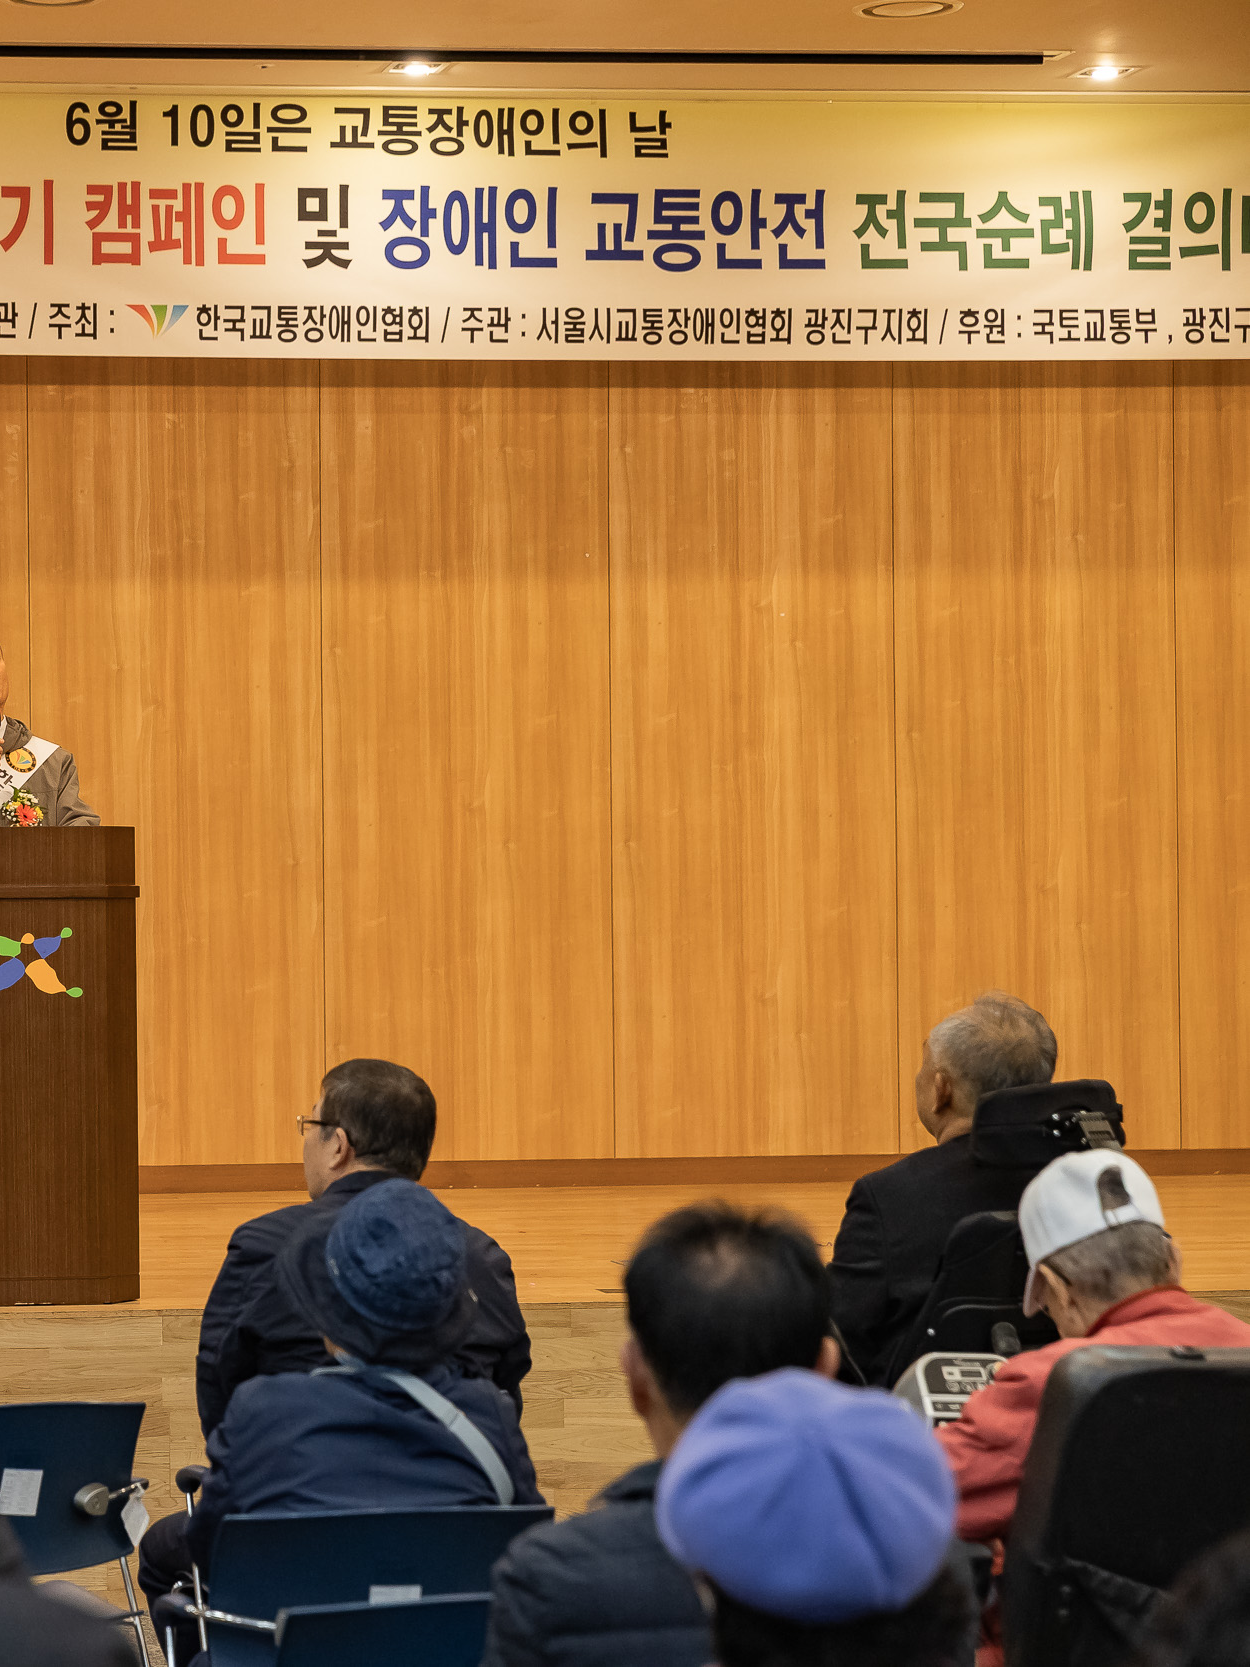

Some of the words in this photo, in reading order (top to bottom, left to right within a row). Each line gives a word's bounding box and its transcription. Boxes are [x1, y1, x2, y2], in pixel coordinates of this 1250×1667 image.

[65, 99, 138, 152] 6월
[162, 102, 312, 154] 10일은
[329, 104, 608, 159] 교통장애인의
[628, 109, 673, 159] 날
[84, 180, 266, 267] 캠페인
[297, 183, 353, 270] 및
[378, 185, 559, 270] 장애인
[584, 188, 827, 273] 교통안전
[852, 189, 1094, 272] 전국순례
[48, 302, 98, 341] 주최
[196, 303, 430, 344] 한국교통장애인협회
[460, 306, 512, 344] 주관
[536, 306, 793, 346] 서울시교통장애인협회
[803, 307, 929, 346] 광진구지회
[957, 307, 1006, 345] 후원
[1032, 308, 1158, 345] 국토교통부
